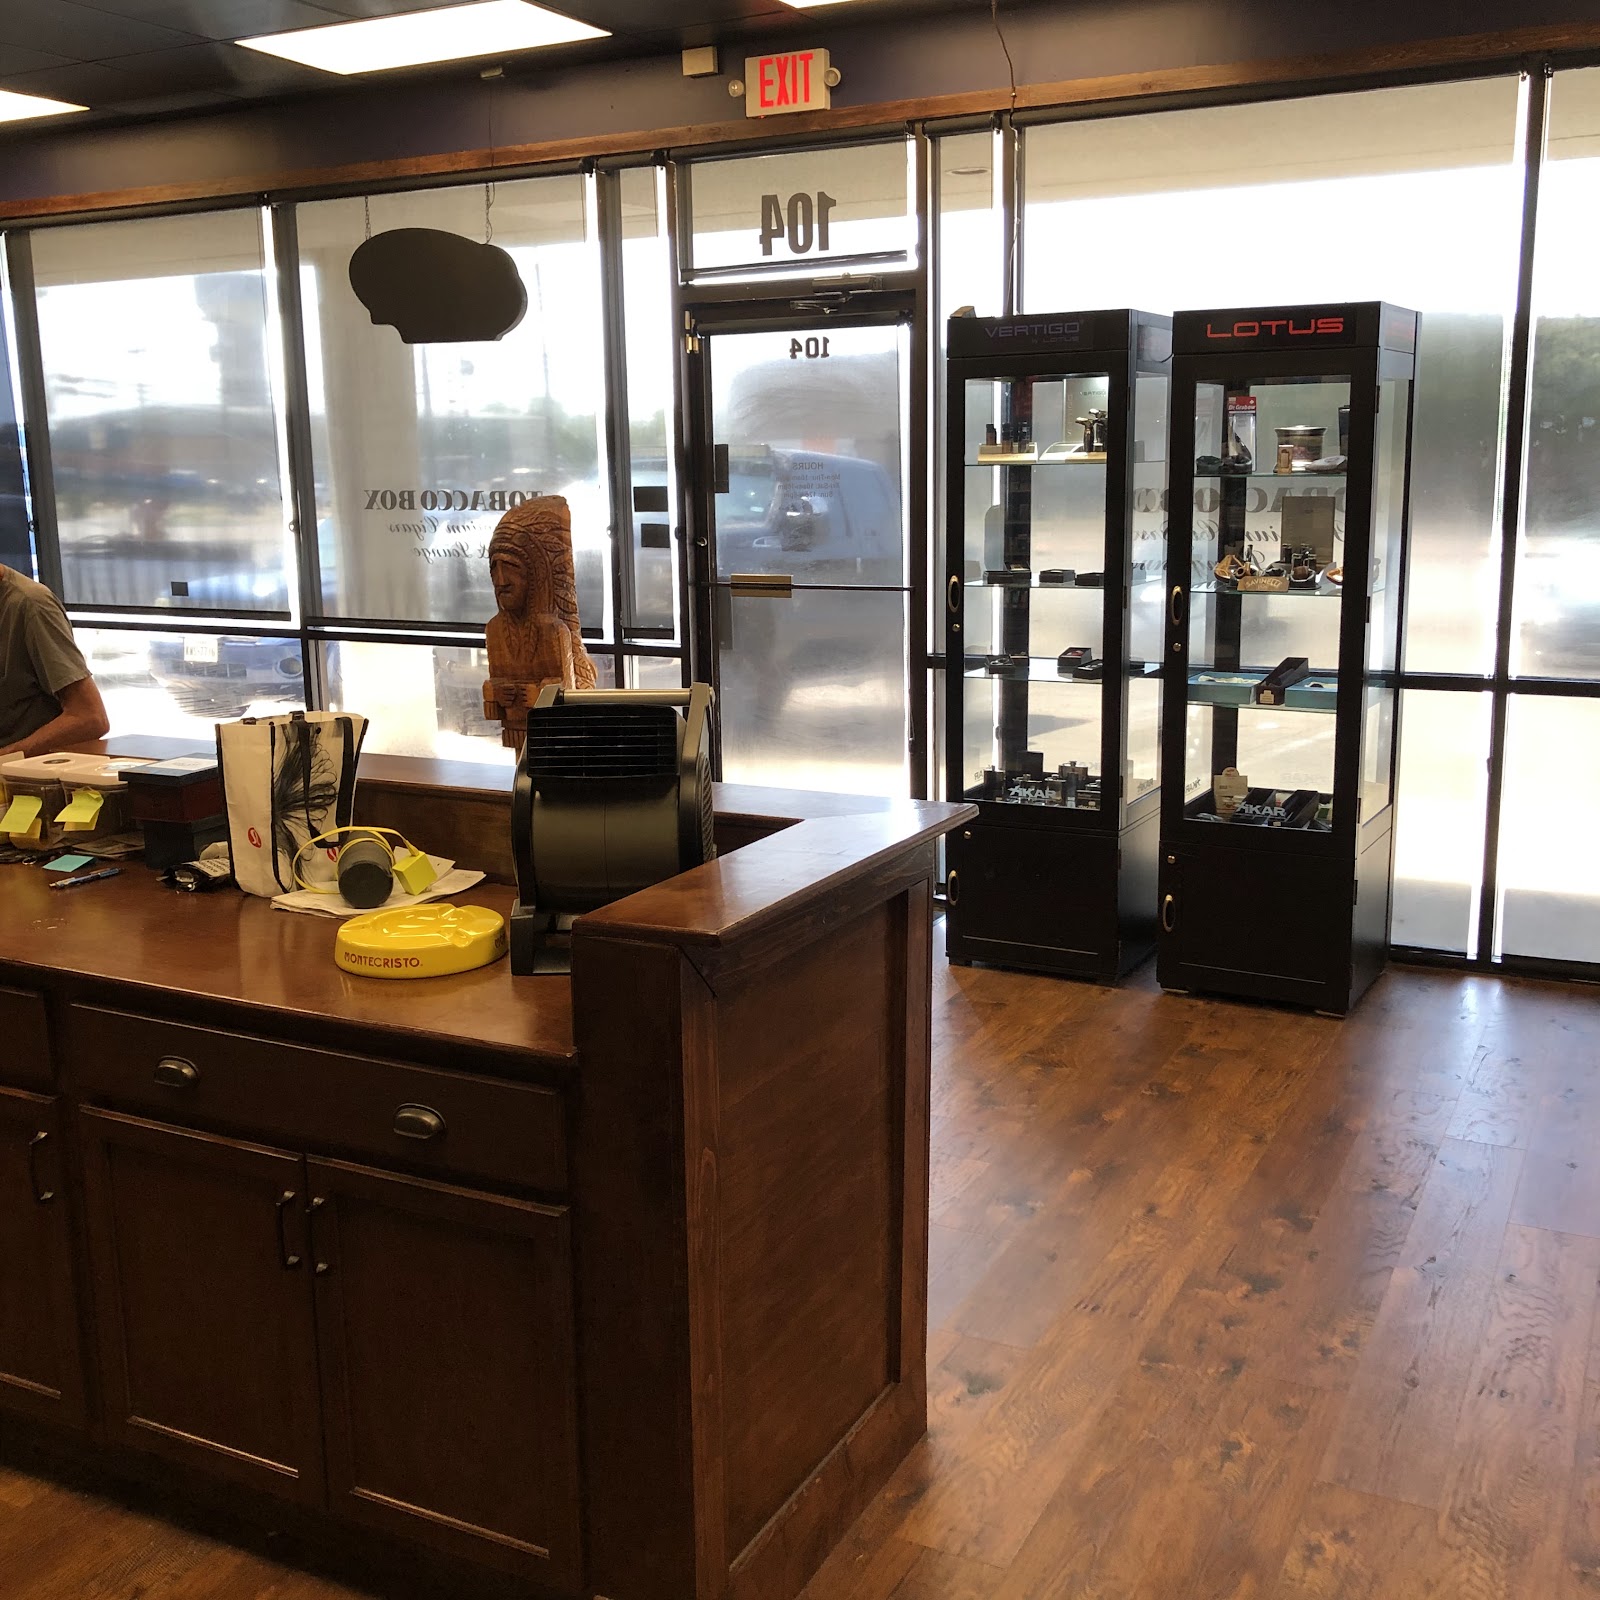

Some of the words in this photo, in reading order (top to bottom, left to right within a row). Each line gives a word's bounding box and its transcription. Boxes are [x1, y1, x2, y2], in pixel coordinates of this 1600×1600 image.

[759, 52, 814, 108] EXIT
[984, 321, 1080, 339] VERTIGO
[1206, 317, 1344, 339] LOTUS
[343, 950, 420, 968] MONTECRISTO
